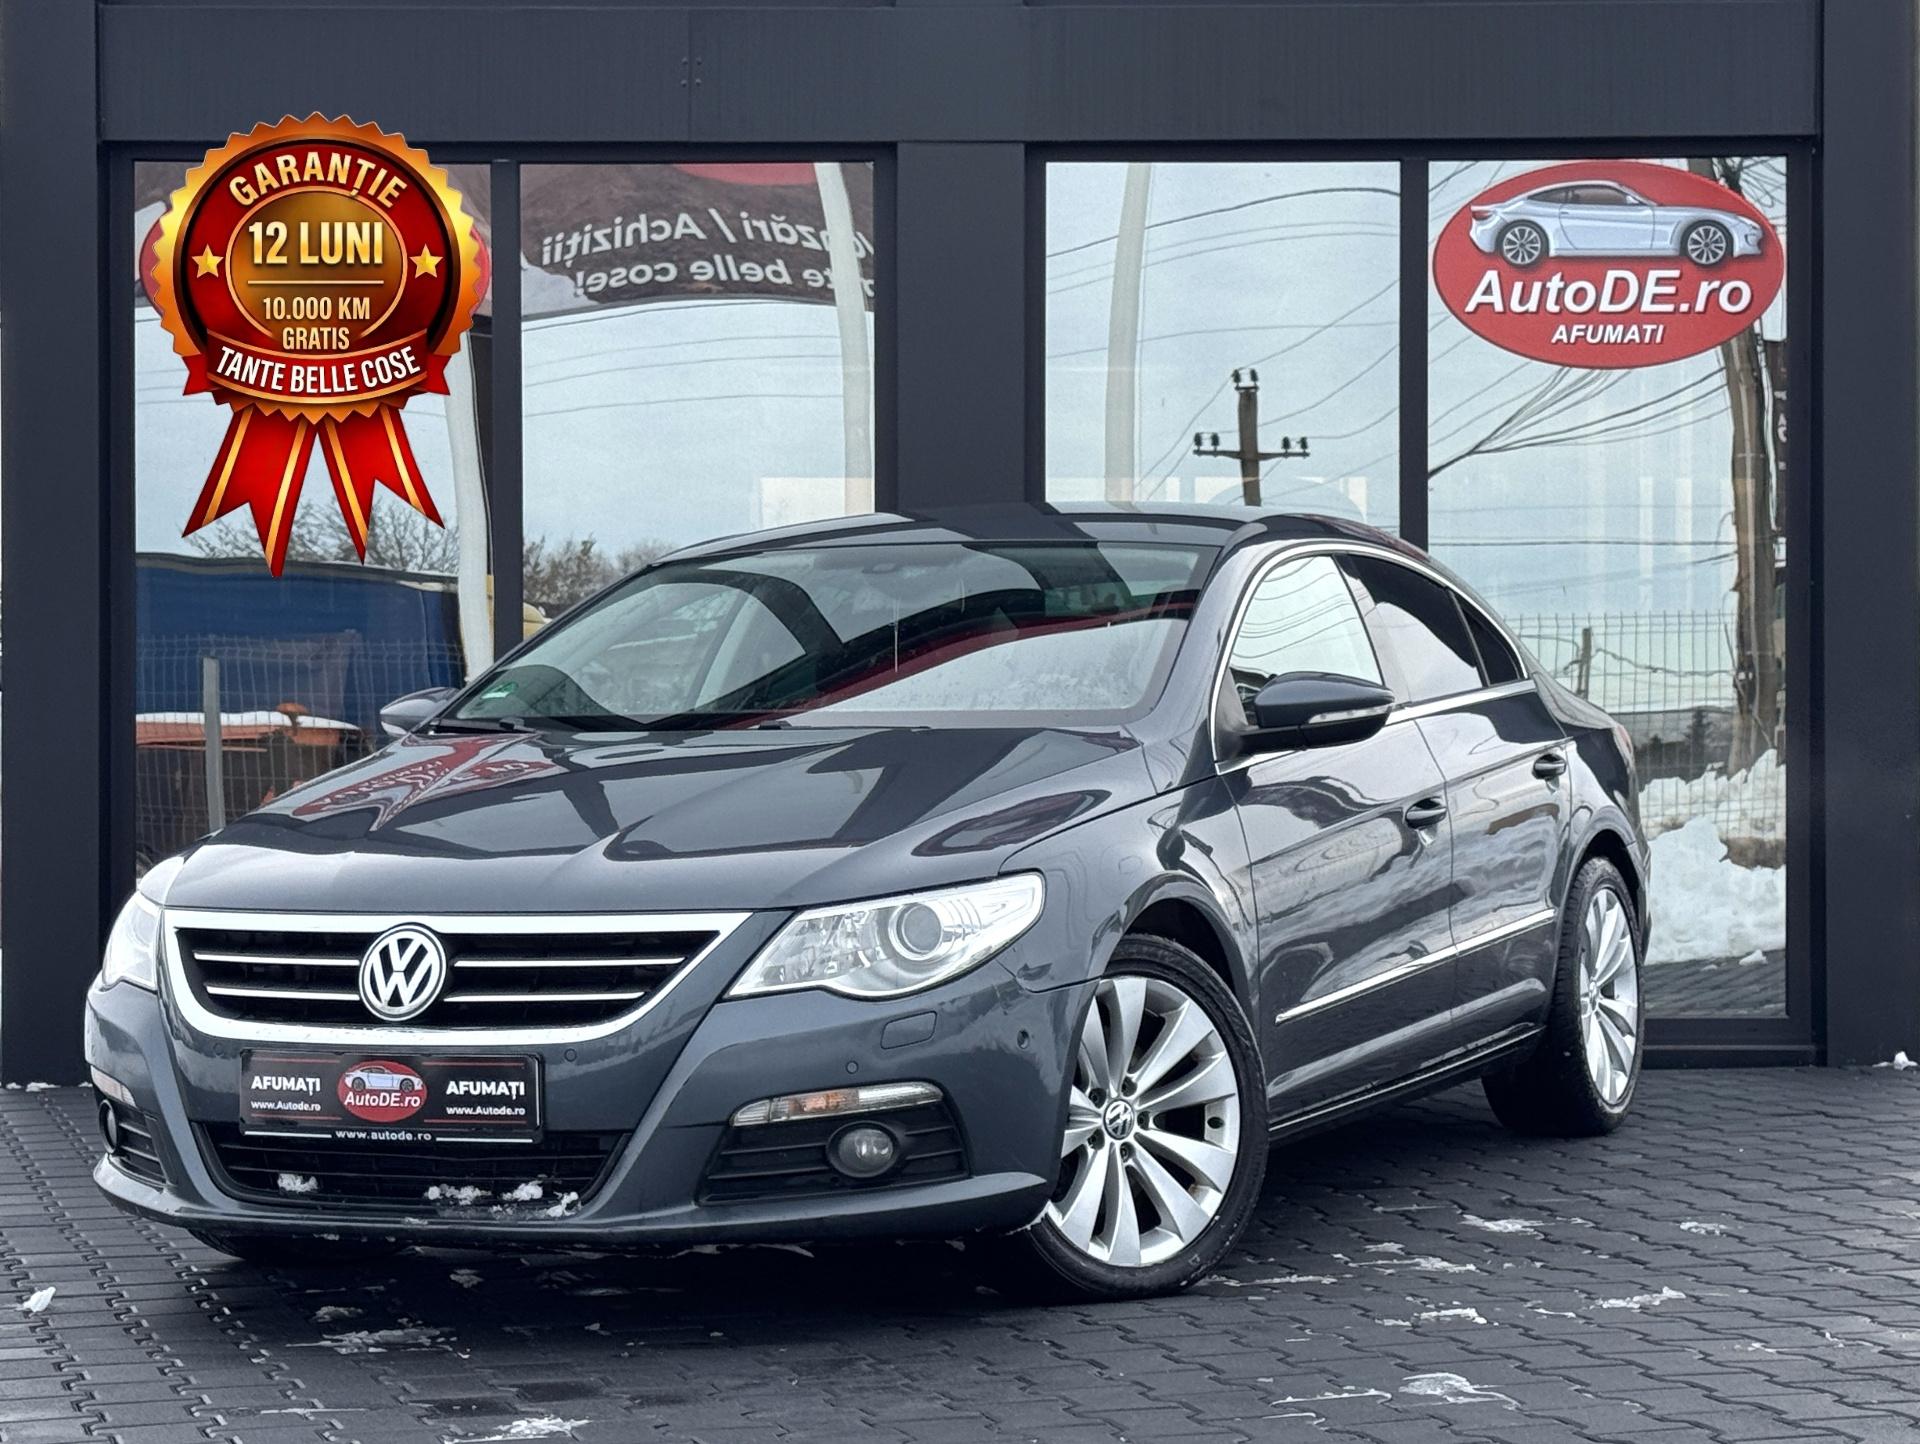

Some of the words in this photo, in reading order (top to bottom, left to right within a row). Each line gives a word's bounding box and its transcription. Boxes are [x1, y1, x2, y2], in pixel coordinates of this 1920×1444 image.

[1464, 269, 1753, 314] AutoDE.ro
[1551, 324, 1665, 345] AFUMATI
[250, 1099, 321, 1112] www.Autode.ro
[344, 1091, 421, 1108] AutoDE.ro
[446, 1105, 526, 1116] www.Autode.ro
[335, 1129, 432, 1142] www.autode.ro
